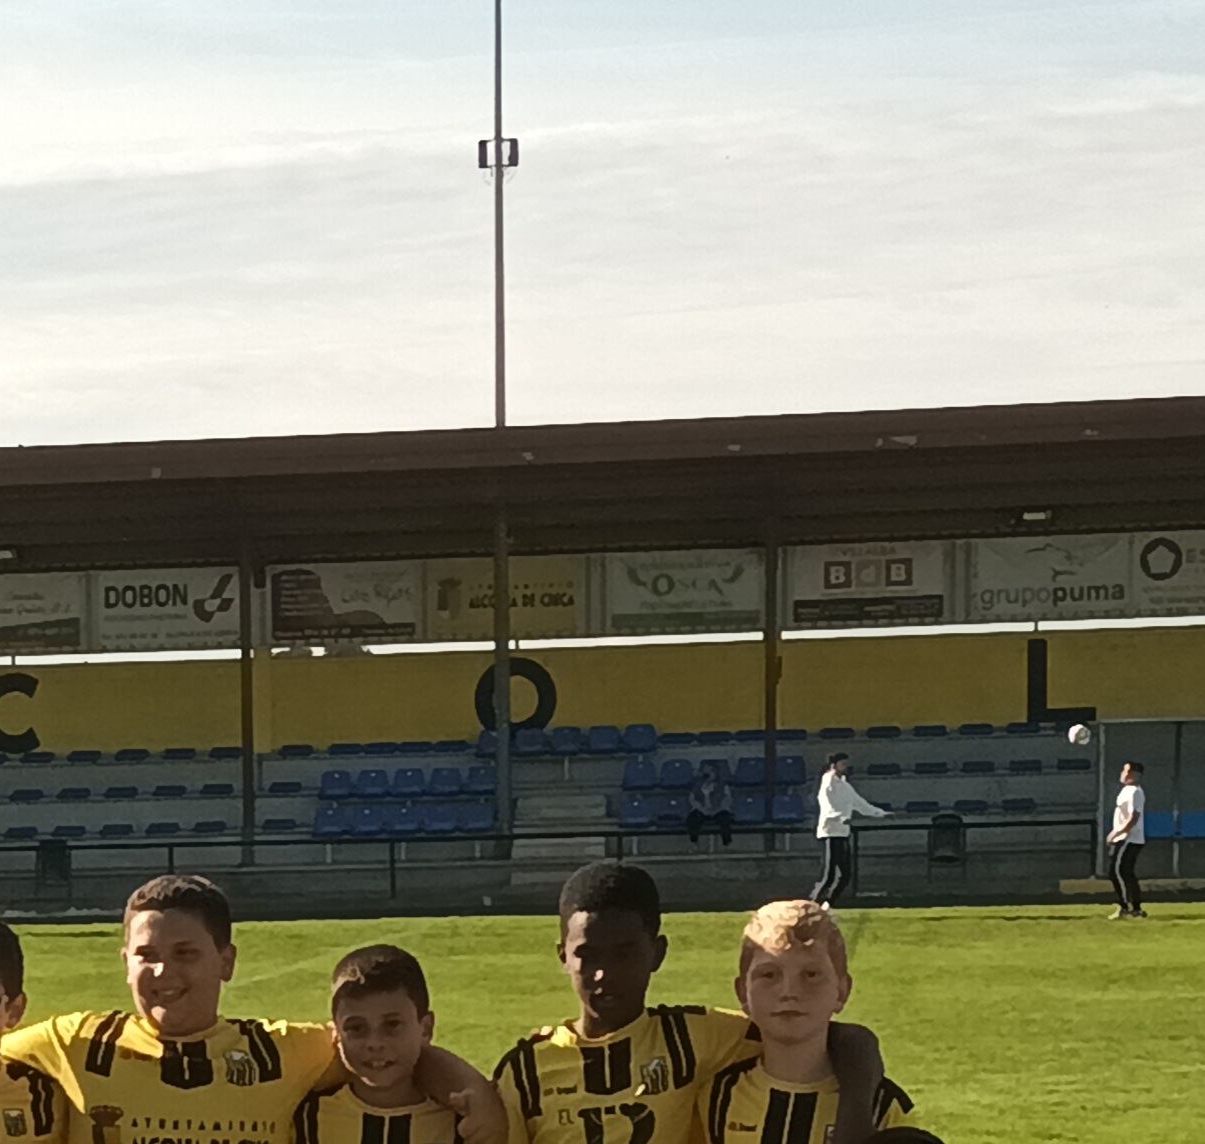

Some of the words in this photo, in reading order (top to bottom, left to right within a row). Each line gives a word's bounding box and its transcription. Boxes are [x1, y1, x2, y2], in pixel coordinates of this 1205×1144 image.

[103, 584, 188, 609] DOBON
[469, 594, 518, 609] ALCOA
[980, 583, 1125, 610] grupopuma
[558, 1108, 575, 1126] EL
